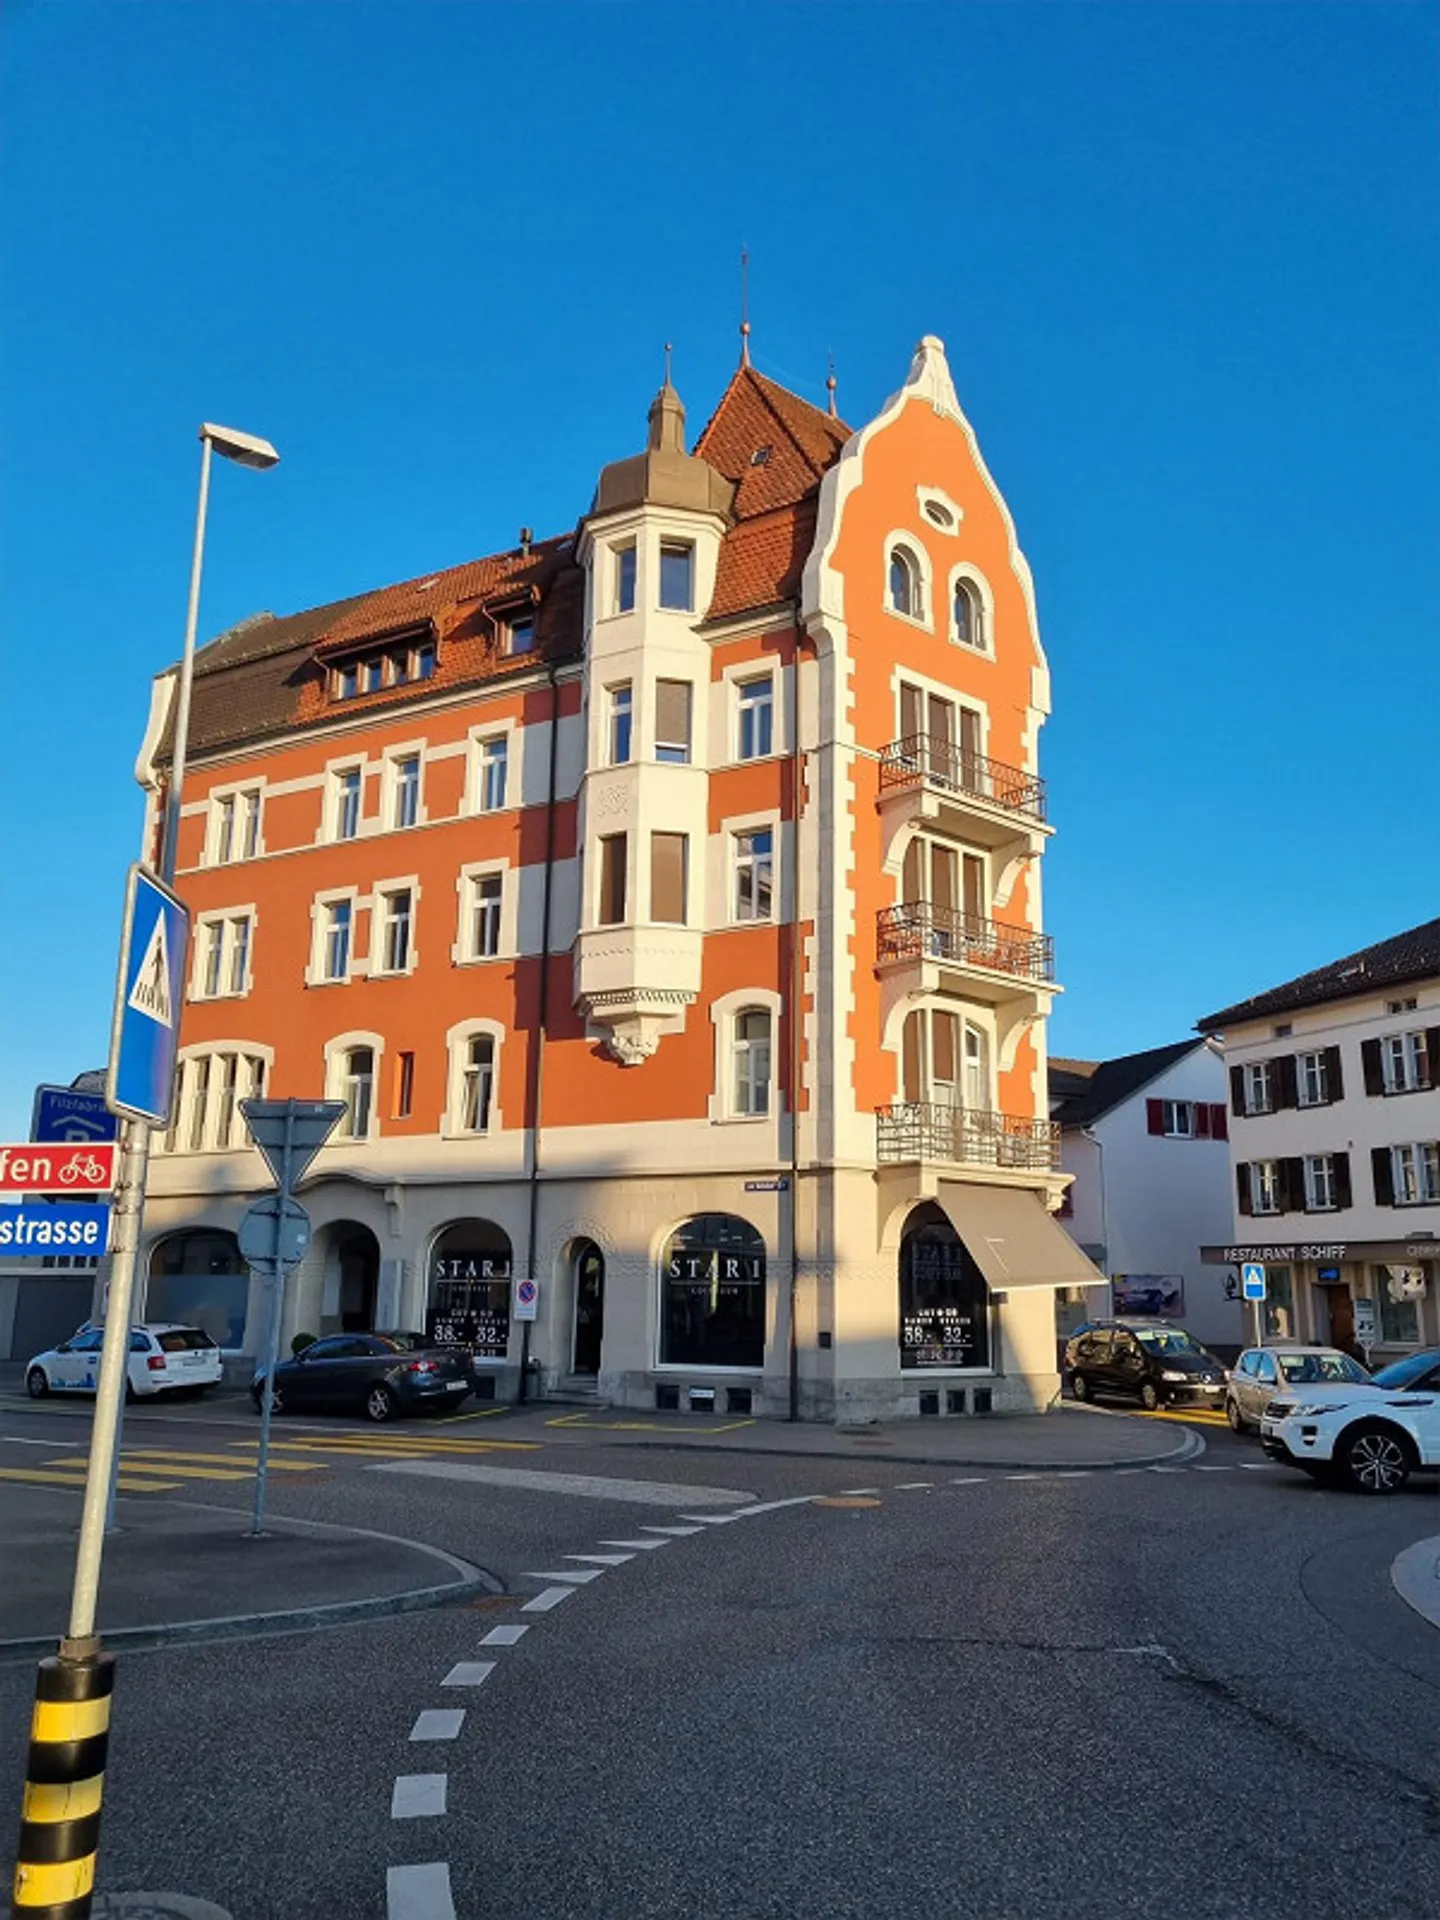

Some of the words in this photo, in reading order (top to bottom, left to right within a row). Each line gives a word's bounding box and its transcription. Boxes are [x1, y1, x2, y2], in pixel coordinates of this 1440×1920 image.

[0, 1149, 51, 1182] fen
[0, 1214, 98, 1245] strasse
[1223, 1247, 1295, 1261] RESTAURANT
[1301, 1245, 1346, 1259] SCHIFF
